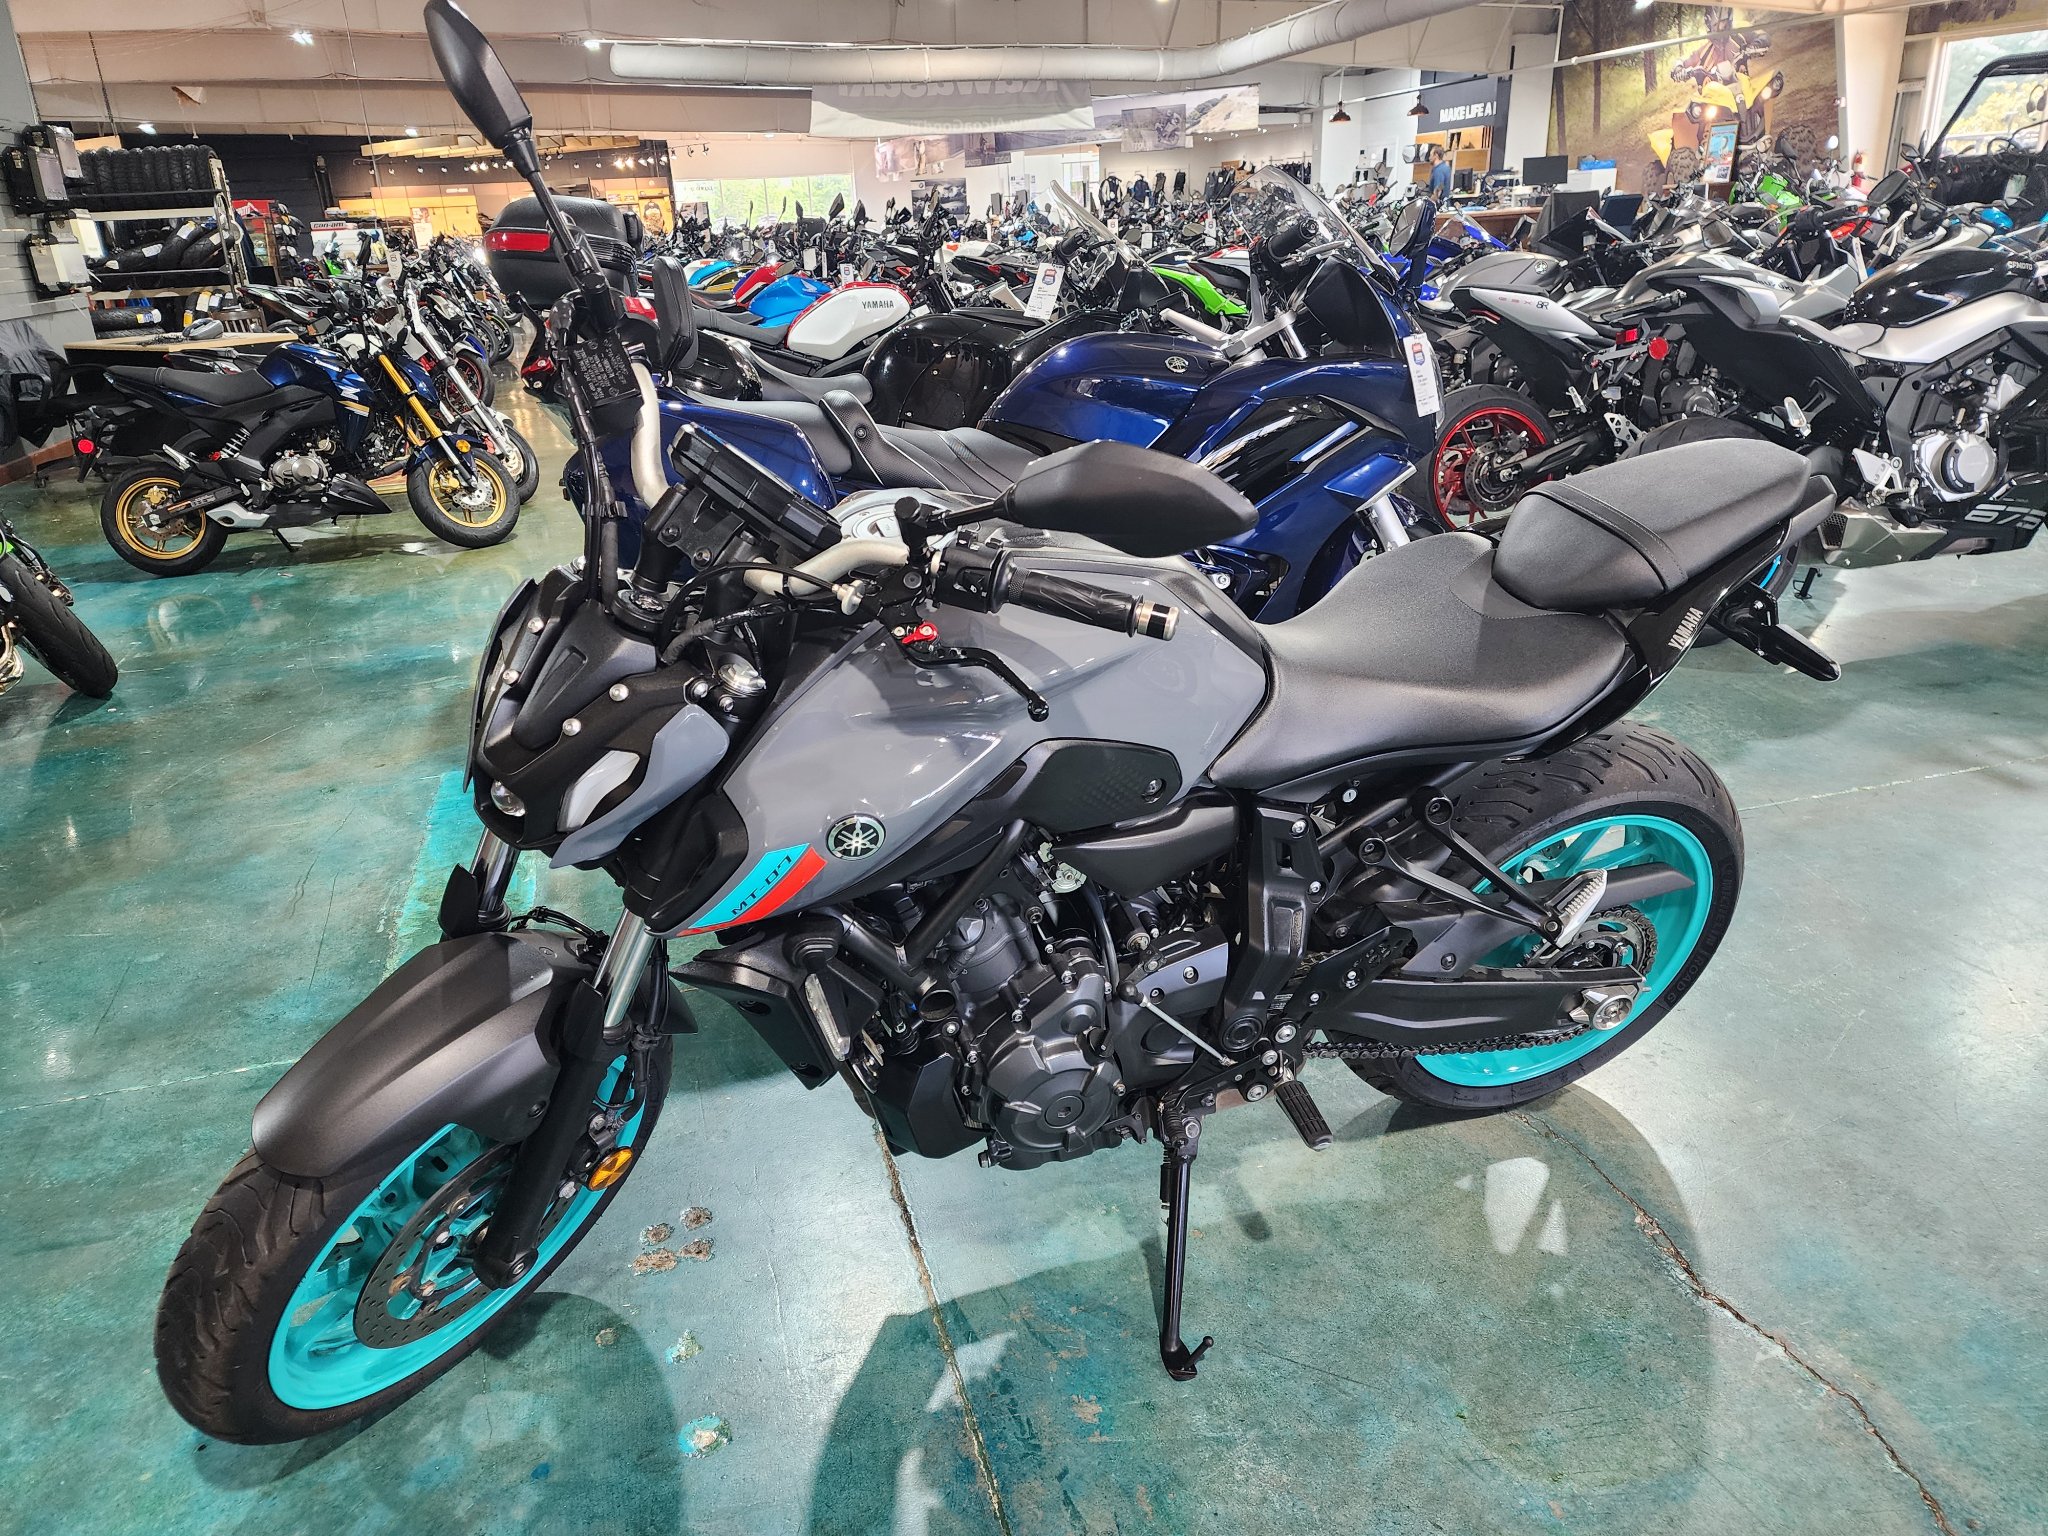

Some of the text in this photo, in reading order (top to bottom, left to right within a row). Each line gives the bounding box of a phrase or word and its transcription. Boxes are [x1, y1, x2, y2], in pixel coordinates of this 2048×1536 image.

[1439, 105, 1466, 123] MAKE
[1465, 102, 1485, 119] LIFE
[1484, 102, 1492, 117] A
[2006, 260, 2033, 270] CFMOTO
[862, 300, 895, 309] YAMAHA
[1536, 300, 1550, 310] 8R
[1668, 607, 1704, 650] YAMAHA
[731, 855, 792, 916] MT-07
